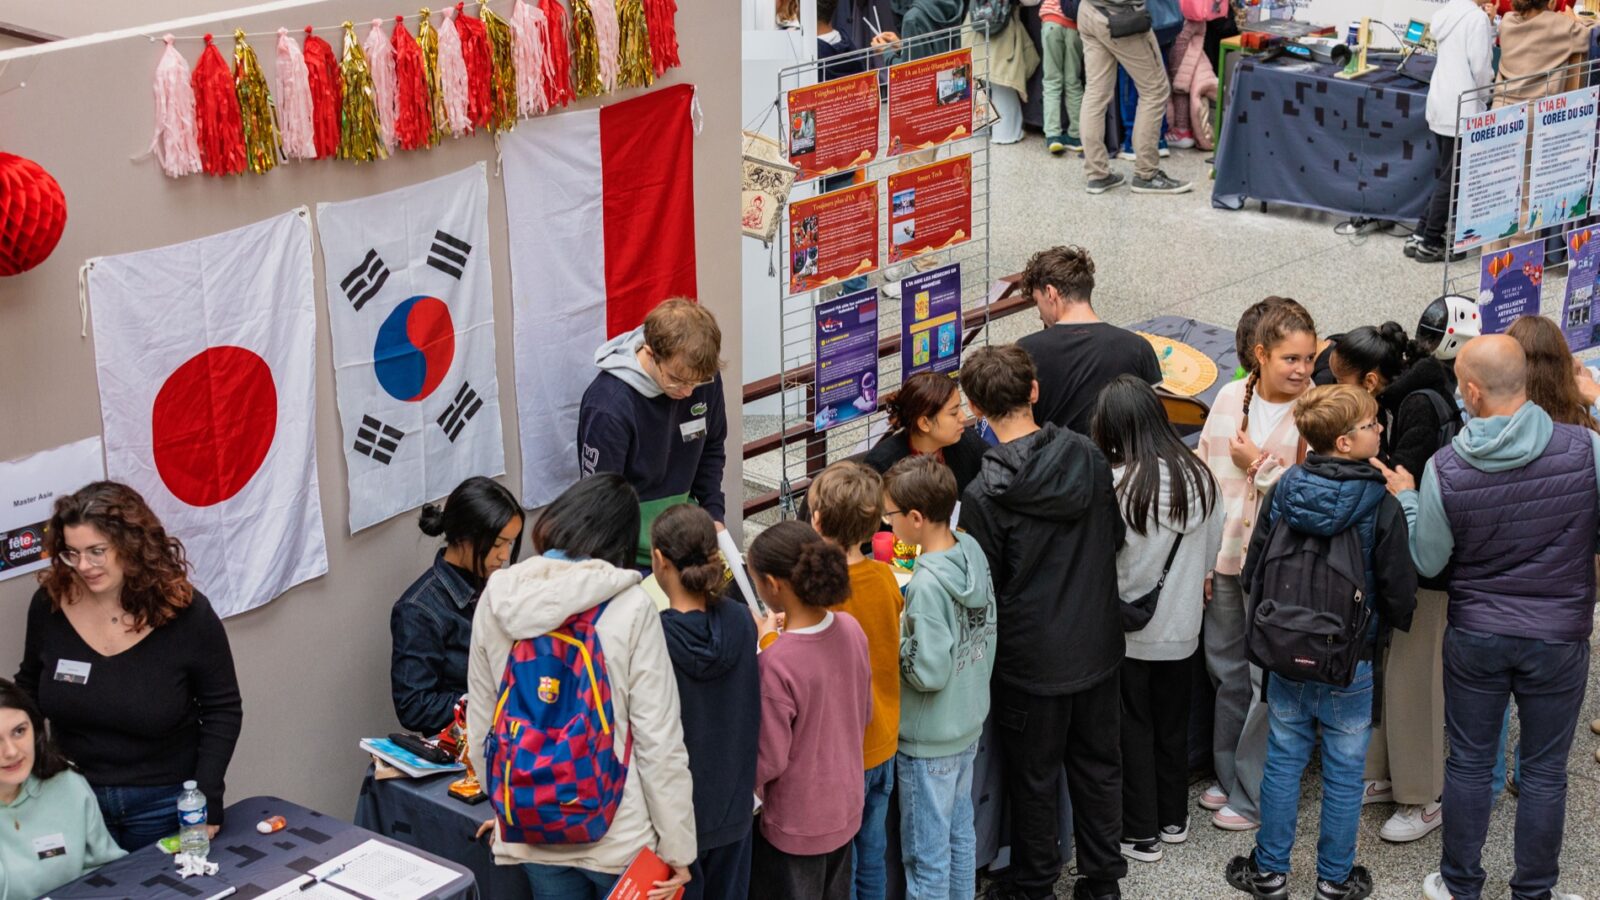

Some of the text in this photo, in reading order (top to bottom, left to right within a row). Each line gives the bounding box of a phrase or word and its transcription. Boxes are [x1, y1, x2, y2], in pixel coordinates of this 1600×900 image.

[1538, 96, 1567, 113] L'IA EN
[1466, 113, 1496, 131] L'IA EN
[1542, 104, 1594, 126] CORÉE DU SUD
[1471, 119, 1524, 143] CORÉE DU SUD
[1495, 298, 1527, 312] L'INTELLIGENCE
[13, 491, 53, 507] Master Asie
[9, 536, 31, 549] fête
[10, 545, 42, 560] Science
